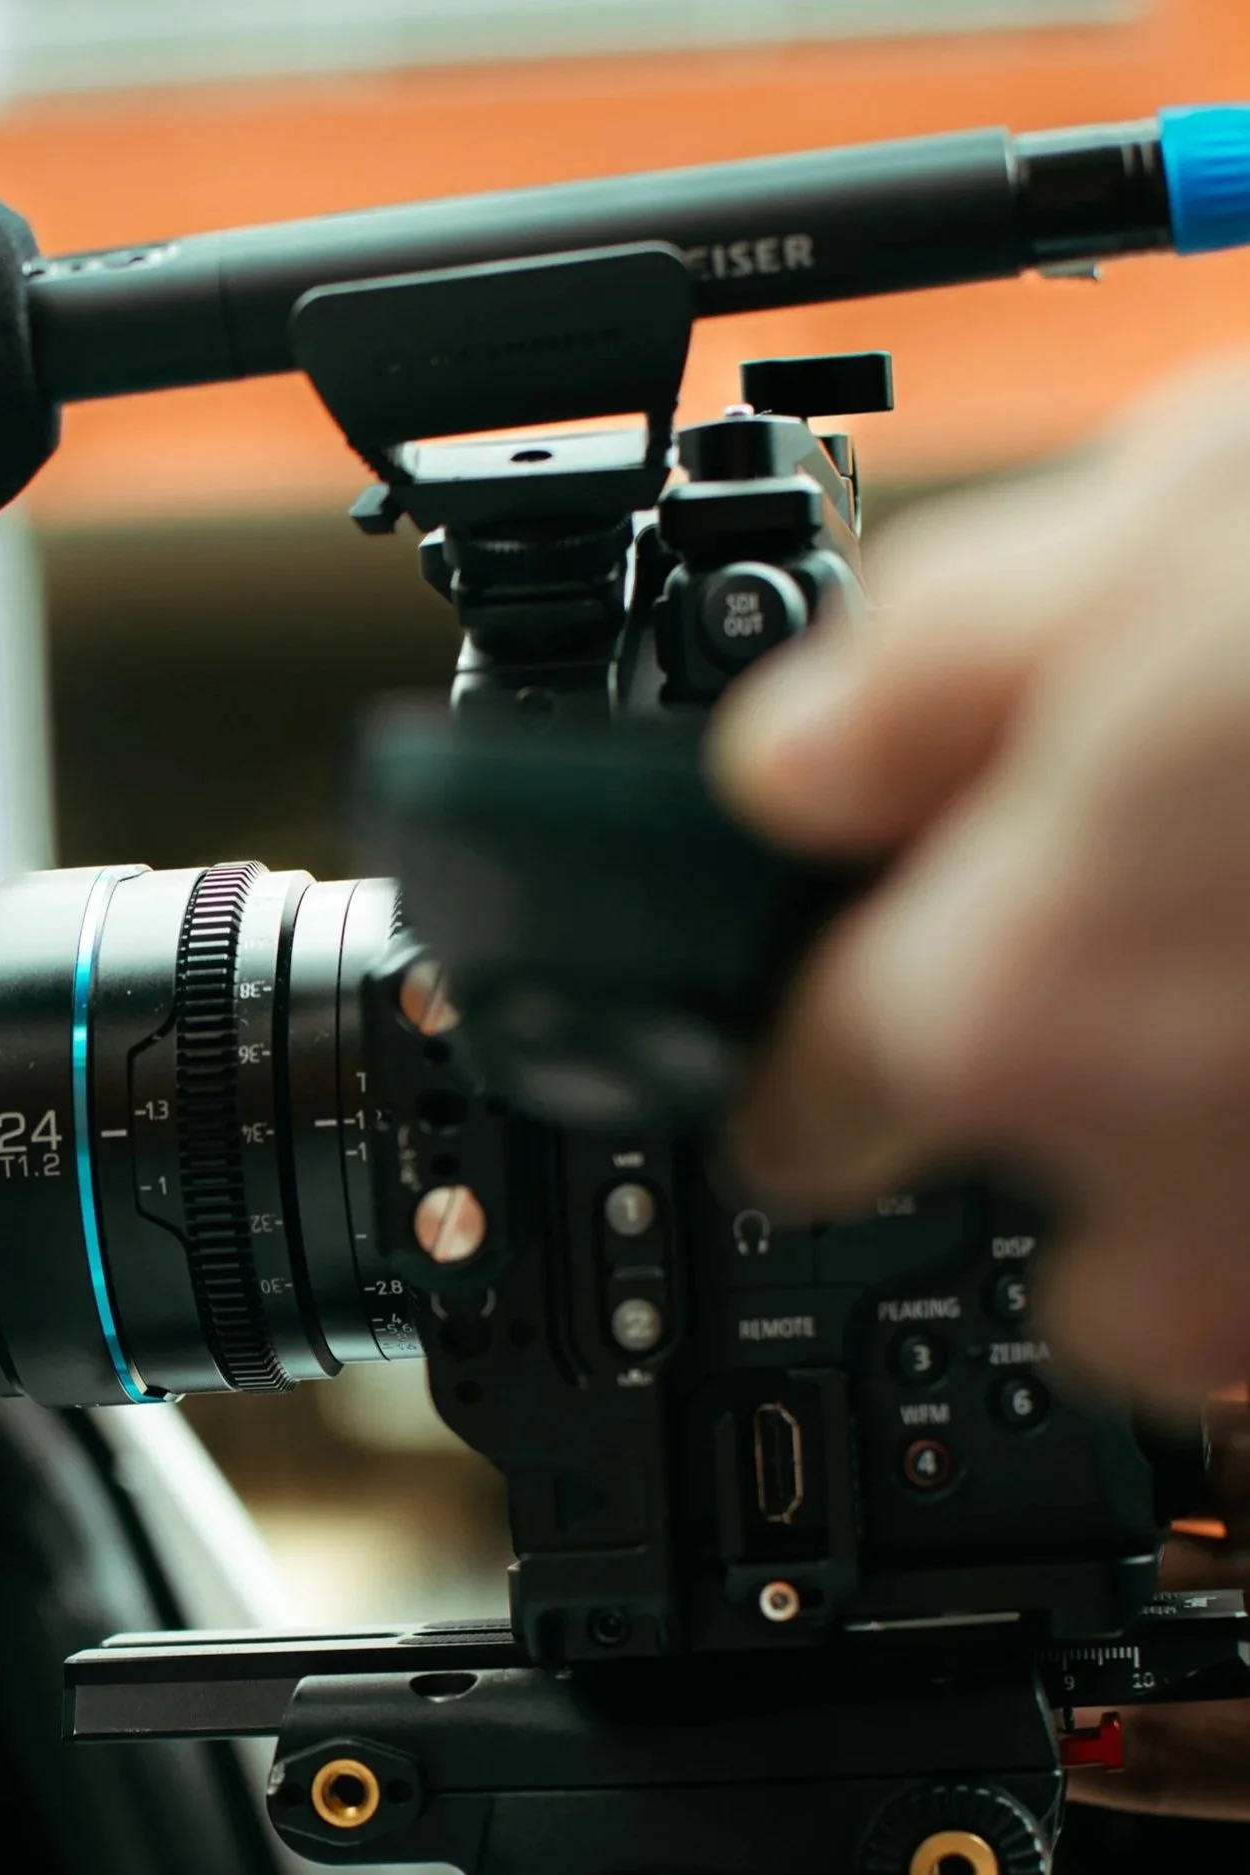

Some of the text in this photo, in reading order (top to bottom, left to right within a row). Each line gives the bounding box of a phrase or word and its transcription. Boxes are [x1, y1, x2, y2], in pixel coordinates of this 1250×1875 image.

[723, 612, 764, 637] OUT
[0, 1152, 61, 1178] T1.2
[623, 1195, 638, 1223] 1
[878, 1296, 960, 1321] PEAKING
[1007, 1285, 1026, 1310] 5
[625, 1308, 651, 1338] 2
[739, 1316, 816, 1339] REMOTE
[912, 1344, 931, 1371] 3
[900, 1403, 949, 1424] WFM
[1012, 1390, 1031, 1415] 6
[917, 1450, 937, 1476] 4
[1063, 1675, 1076, 1691] 9
[1132, 1672, 1155, 1690] 10
